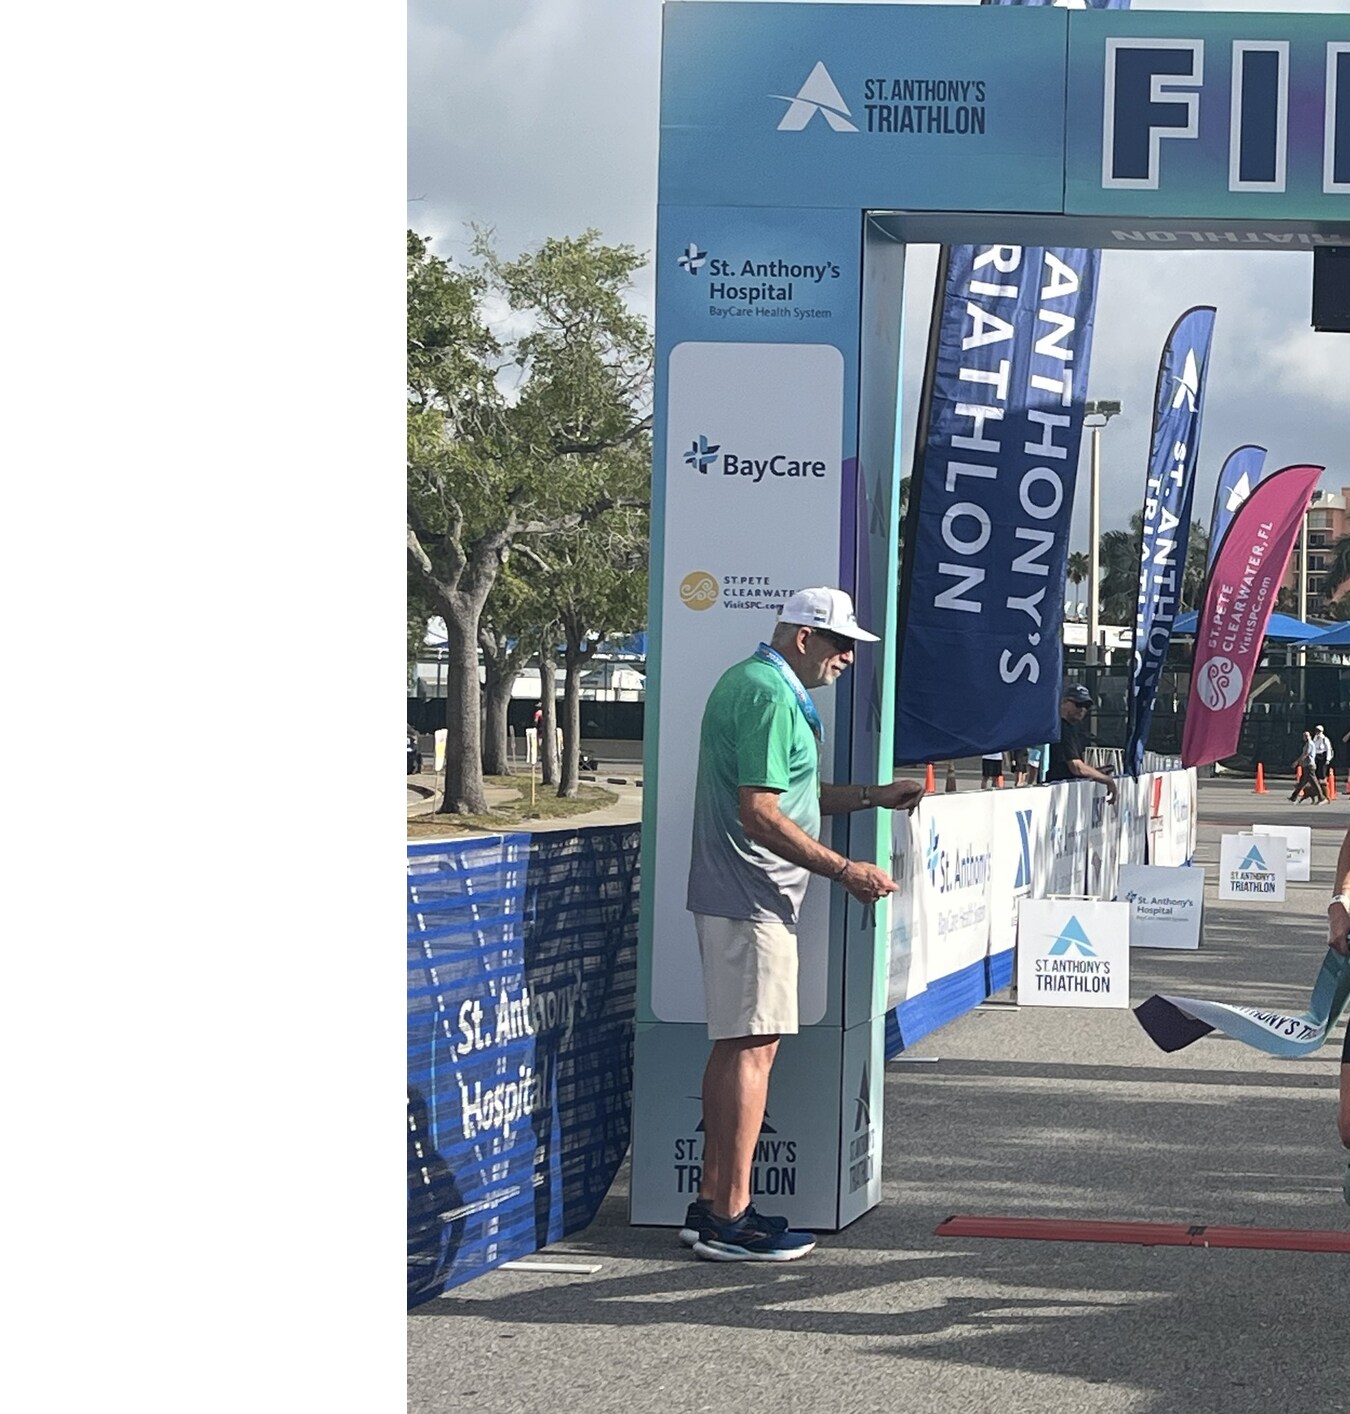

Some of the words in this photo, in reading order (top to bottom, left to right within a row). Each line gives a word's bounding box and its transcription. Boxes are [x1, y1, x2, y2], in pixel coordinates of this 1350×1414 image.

[864, 79, 888, 100] ST.
[891, 79, 986, 102] ANTHONY'S
[864, 104, 985, 134] TRIATHLON
[710, 259, 735, 276] St.
[741, 259, 840, 283] Anthony's
[710, 282, 792, 305] Hospital
[709, 306, 753, 318] BayCare
[756, 307, 791, 317] Health
[794, 307, 831, 320] System
[933, 245, 1022, 614] RIATHLON
[723, 455, 826, 483] BayCare
[999, 251, 1079, 685] ANTHONY'S
[724, 589, 796, 598] CLEARWATE
[1230, 881, 1275, 893] TRIATHLON
[1137, 906, 1173, 915] Hospital
[1151, 897, 1193, 908] Anthony's
[1035, 959, 1050, 972] ST.
[1052, 960, 1110, 974] ANTHONY'S
[1035, 975, 1110, 993] TRIATHLON
[457, 999, 492, 1055] St.
[461, 1054, 550, 1139] Hospital
[675, 1139, 698, 1160] ST.
[674, 1165, 796, 1195] TRLON
